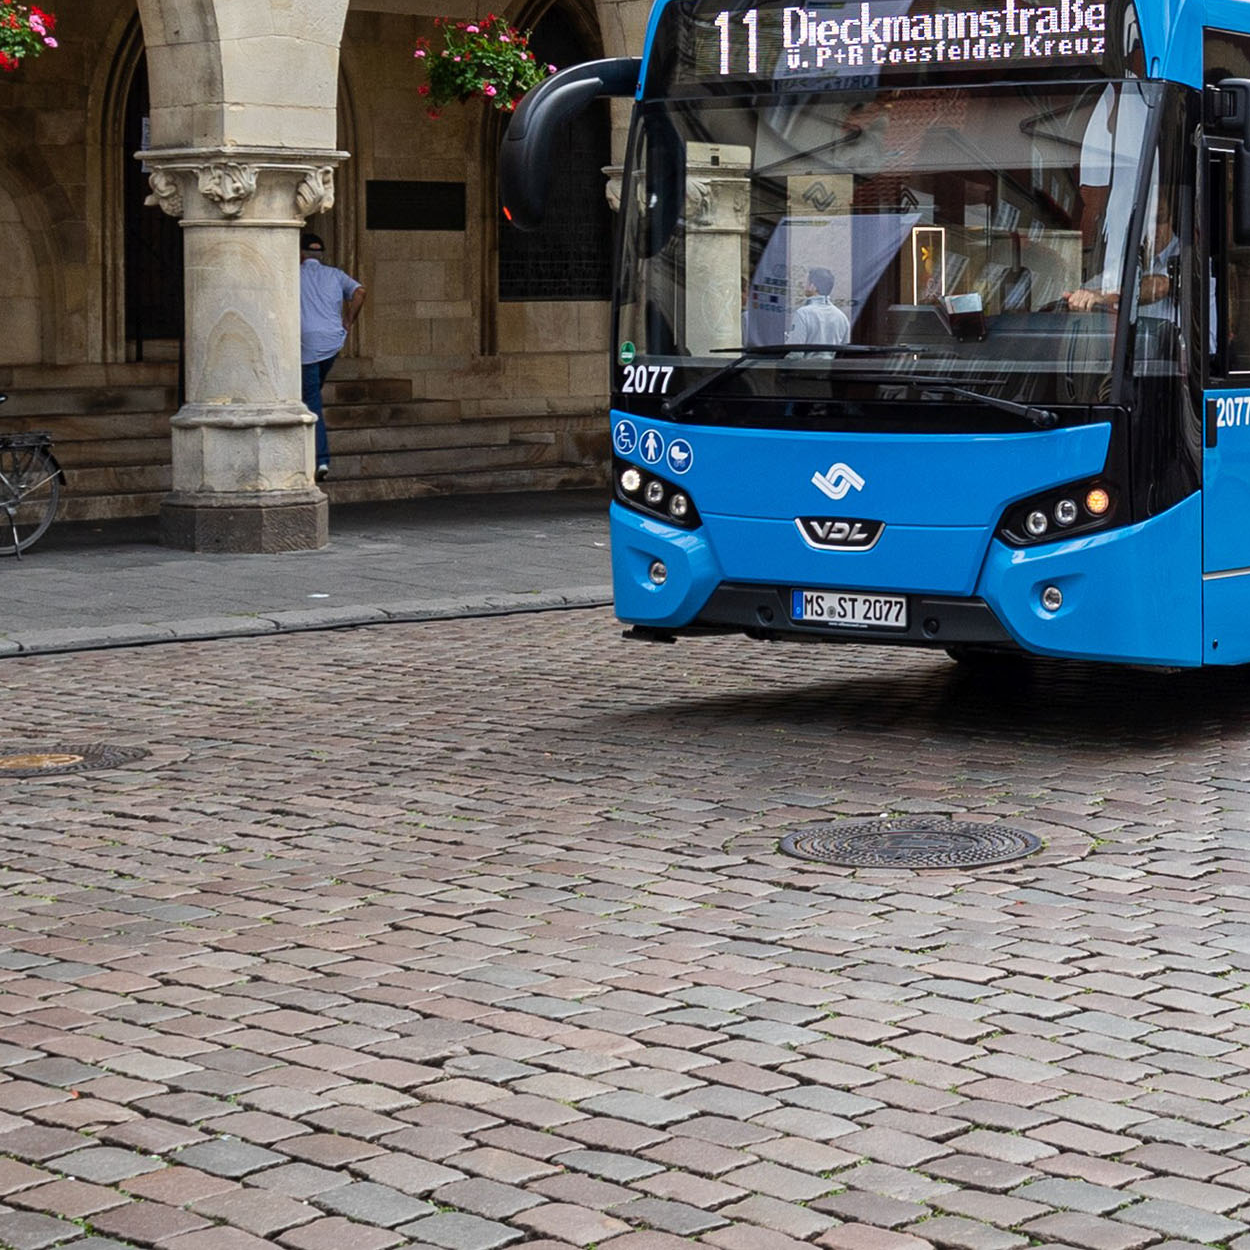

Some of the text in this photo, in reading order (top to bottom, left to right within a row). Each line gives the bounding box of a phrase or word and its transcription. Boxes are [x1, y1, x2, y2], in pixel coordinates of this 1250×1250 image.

[714, 9, 757, 74] 11
[786, 35, 1105, 69] ü. P+R Coesfelder Kreuz
[622, 365, 673, 394] 2077
[810, 521, 868, 541] VDL
[804, 595, 825, 617] MS
[838, 596, 858, 620] ST
[863, 598, 904, 623] 2077
